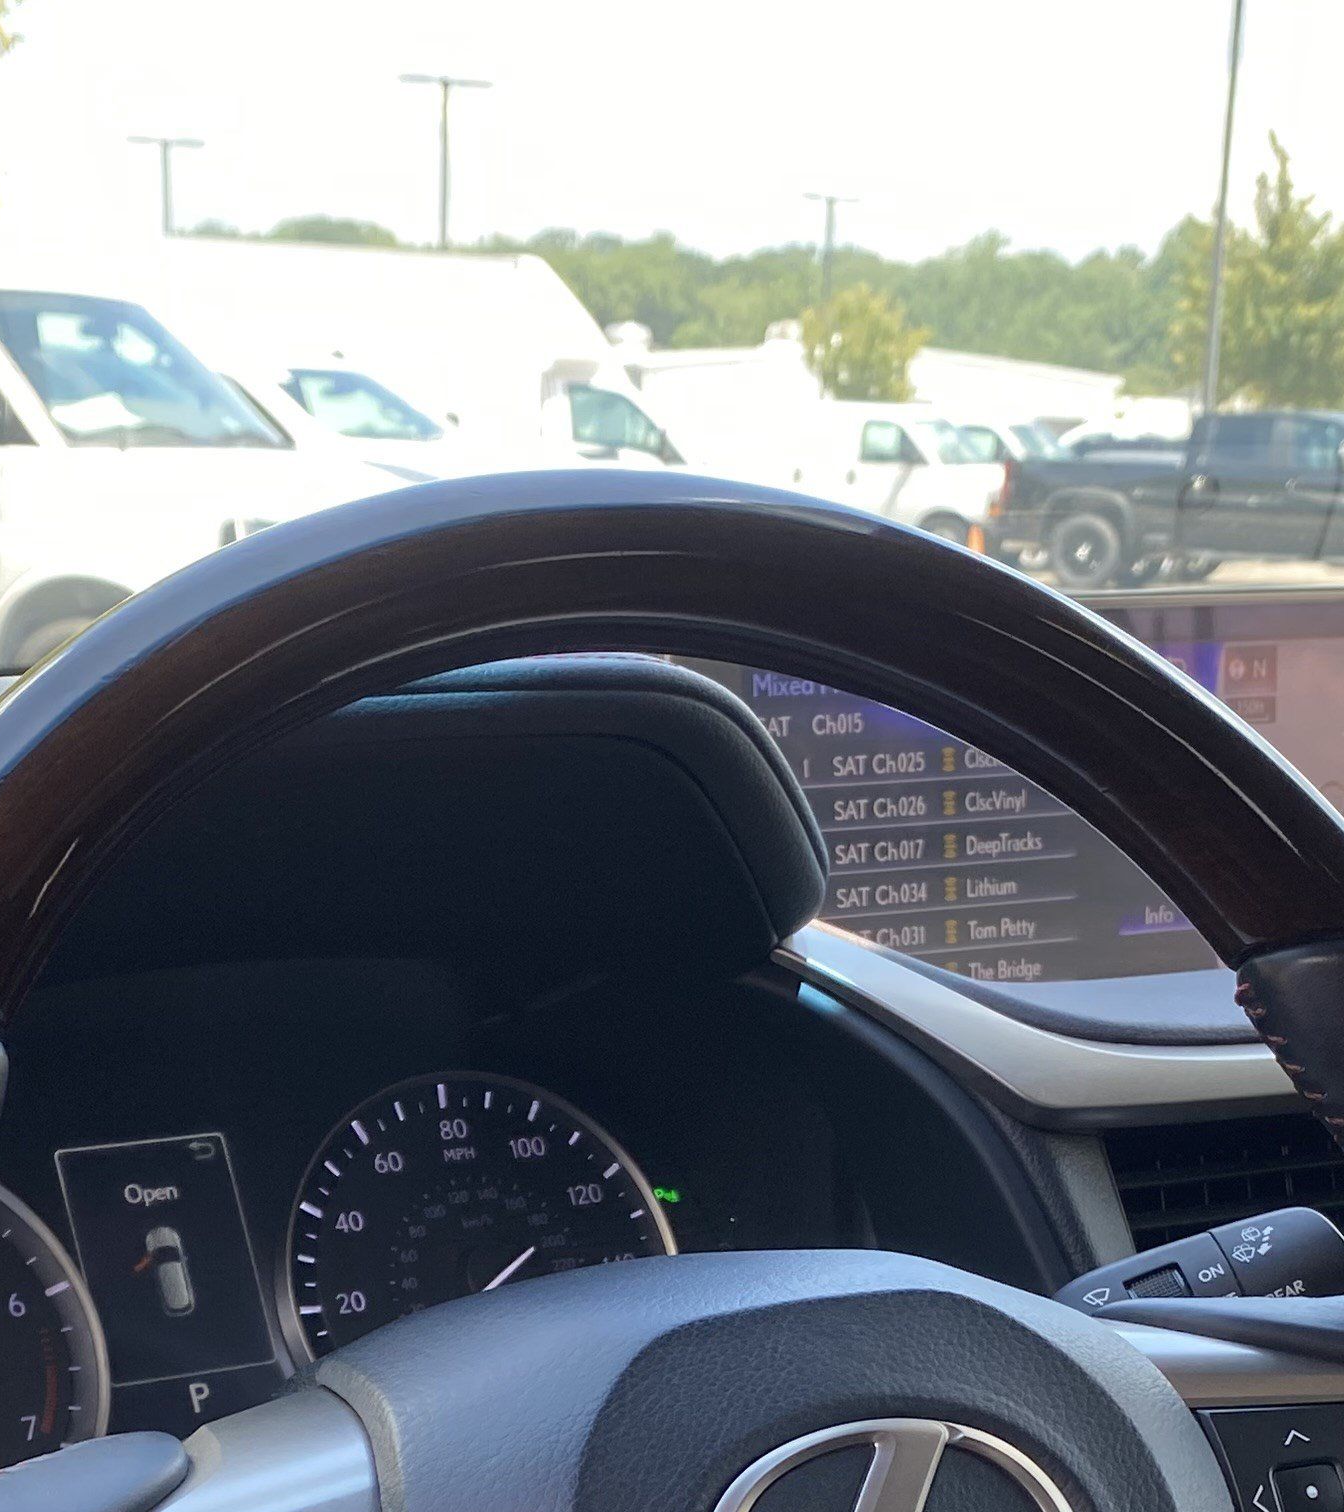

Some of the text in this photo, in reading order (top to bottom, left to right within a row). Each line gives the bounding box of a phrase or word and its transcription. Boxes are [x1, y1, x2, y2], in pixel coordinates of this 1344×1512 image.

[812, 713, 865, 736] Ch015
[832, 755, 866, 777] SAT
[872, 752, 925, 775] Ch025
[834, 799, 867, 822] SAT
[873, 796, 927, 818] Ch026
[835, 832, 1044, 865] SAT Ch017 DeepTracks
[836, 878, 1018, 909] SAT Ch034 Lithium
[1145, 905, 1173, 924] Info
[967, 920, 997, 940] Tom
[1000, 919, 1037, 941] Petty
[969, 959, 1042, 980] The Bridge
[439, 1119, 468, 1140] 80
[443, 1146, 476, 1162] MPH
[508, 1137, 546, 1158] 100
[374, 1152, 403, 1174] 60
[124, 1183, 178, 1206] Open
[566, 1183, 602, 1205] 120
[336, 1212, 363, 1233] 40
[1198, 1263, 1225, 1282] ON
[8, 1293, 26, 1317] 6
[336, 1291, 366, 1315] 20
[189, 1382, 210, 1413] P
[20, 1415, 37, 1441] 7
